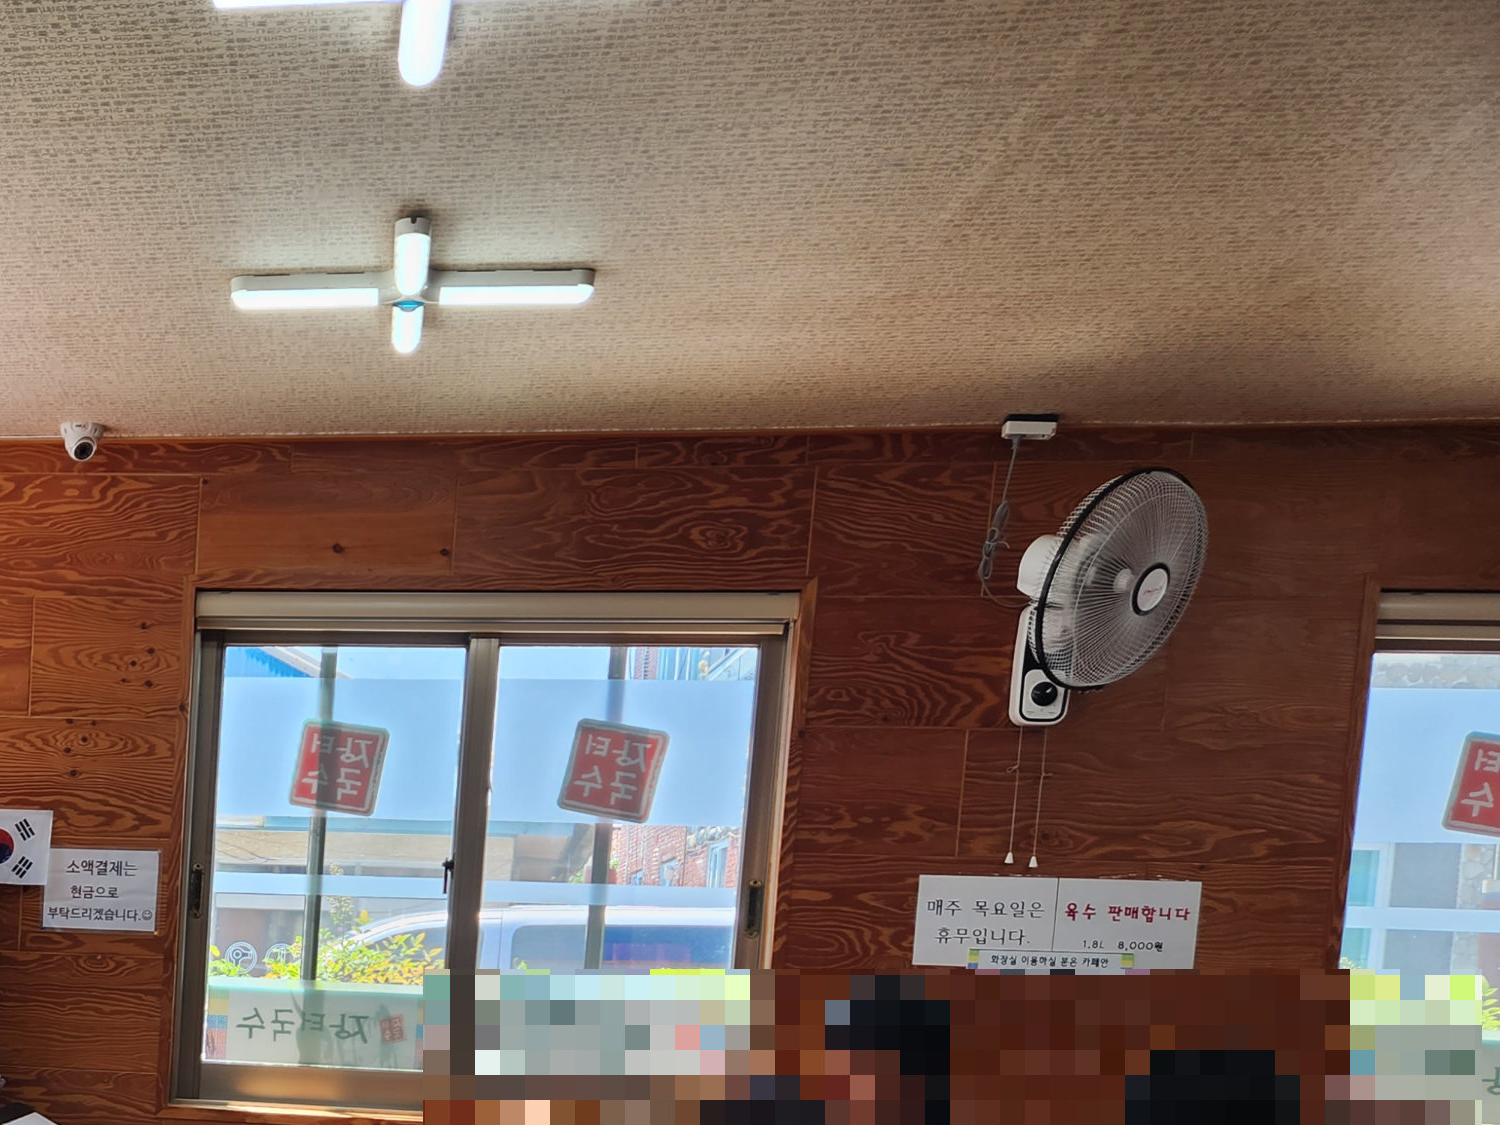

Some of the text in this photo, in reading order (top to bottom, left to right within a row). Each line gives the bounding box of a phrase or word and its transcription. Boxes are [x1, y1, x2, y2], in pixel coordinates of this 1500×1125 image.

[65, 859, 138, 877] 소액결제는
[70, 885, 120, 900] 현금으로
[47, 906, 142, 922] 부탁드리겠습니다.
[926, 899, 1045, 919] 매주 목요일은
[1064, 902, 1191, 924] 육수 판매합니다
[934, 927, 1031, 946] 휴무입니다.
[1082, 940, 1164, 952] 1.8L 8,000원
[990, 954, 1018, 966] 화장실
[1021, 955, 1057, 968] 이용하실
[1060, 956, 1078, 968] 분은
